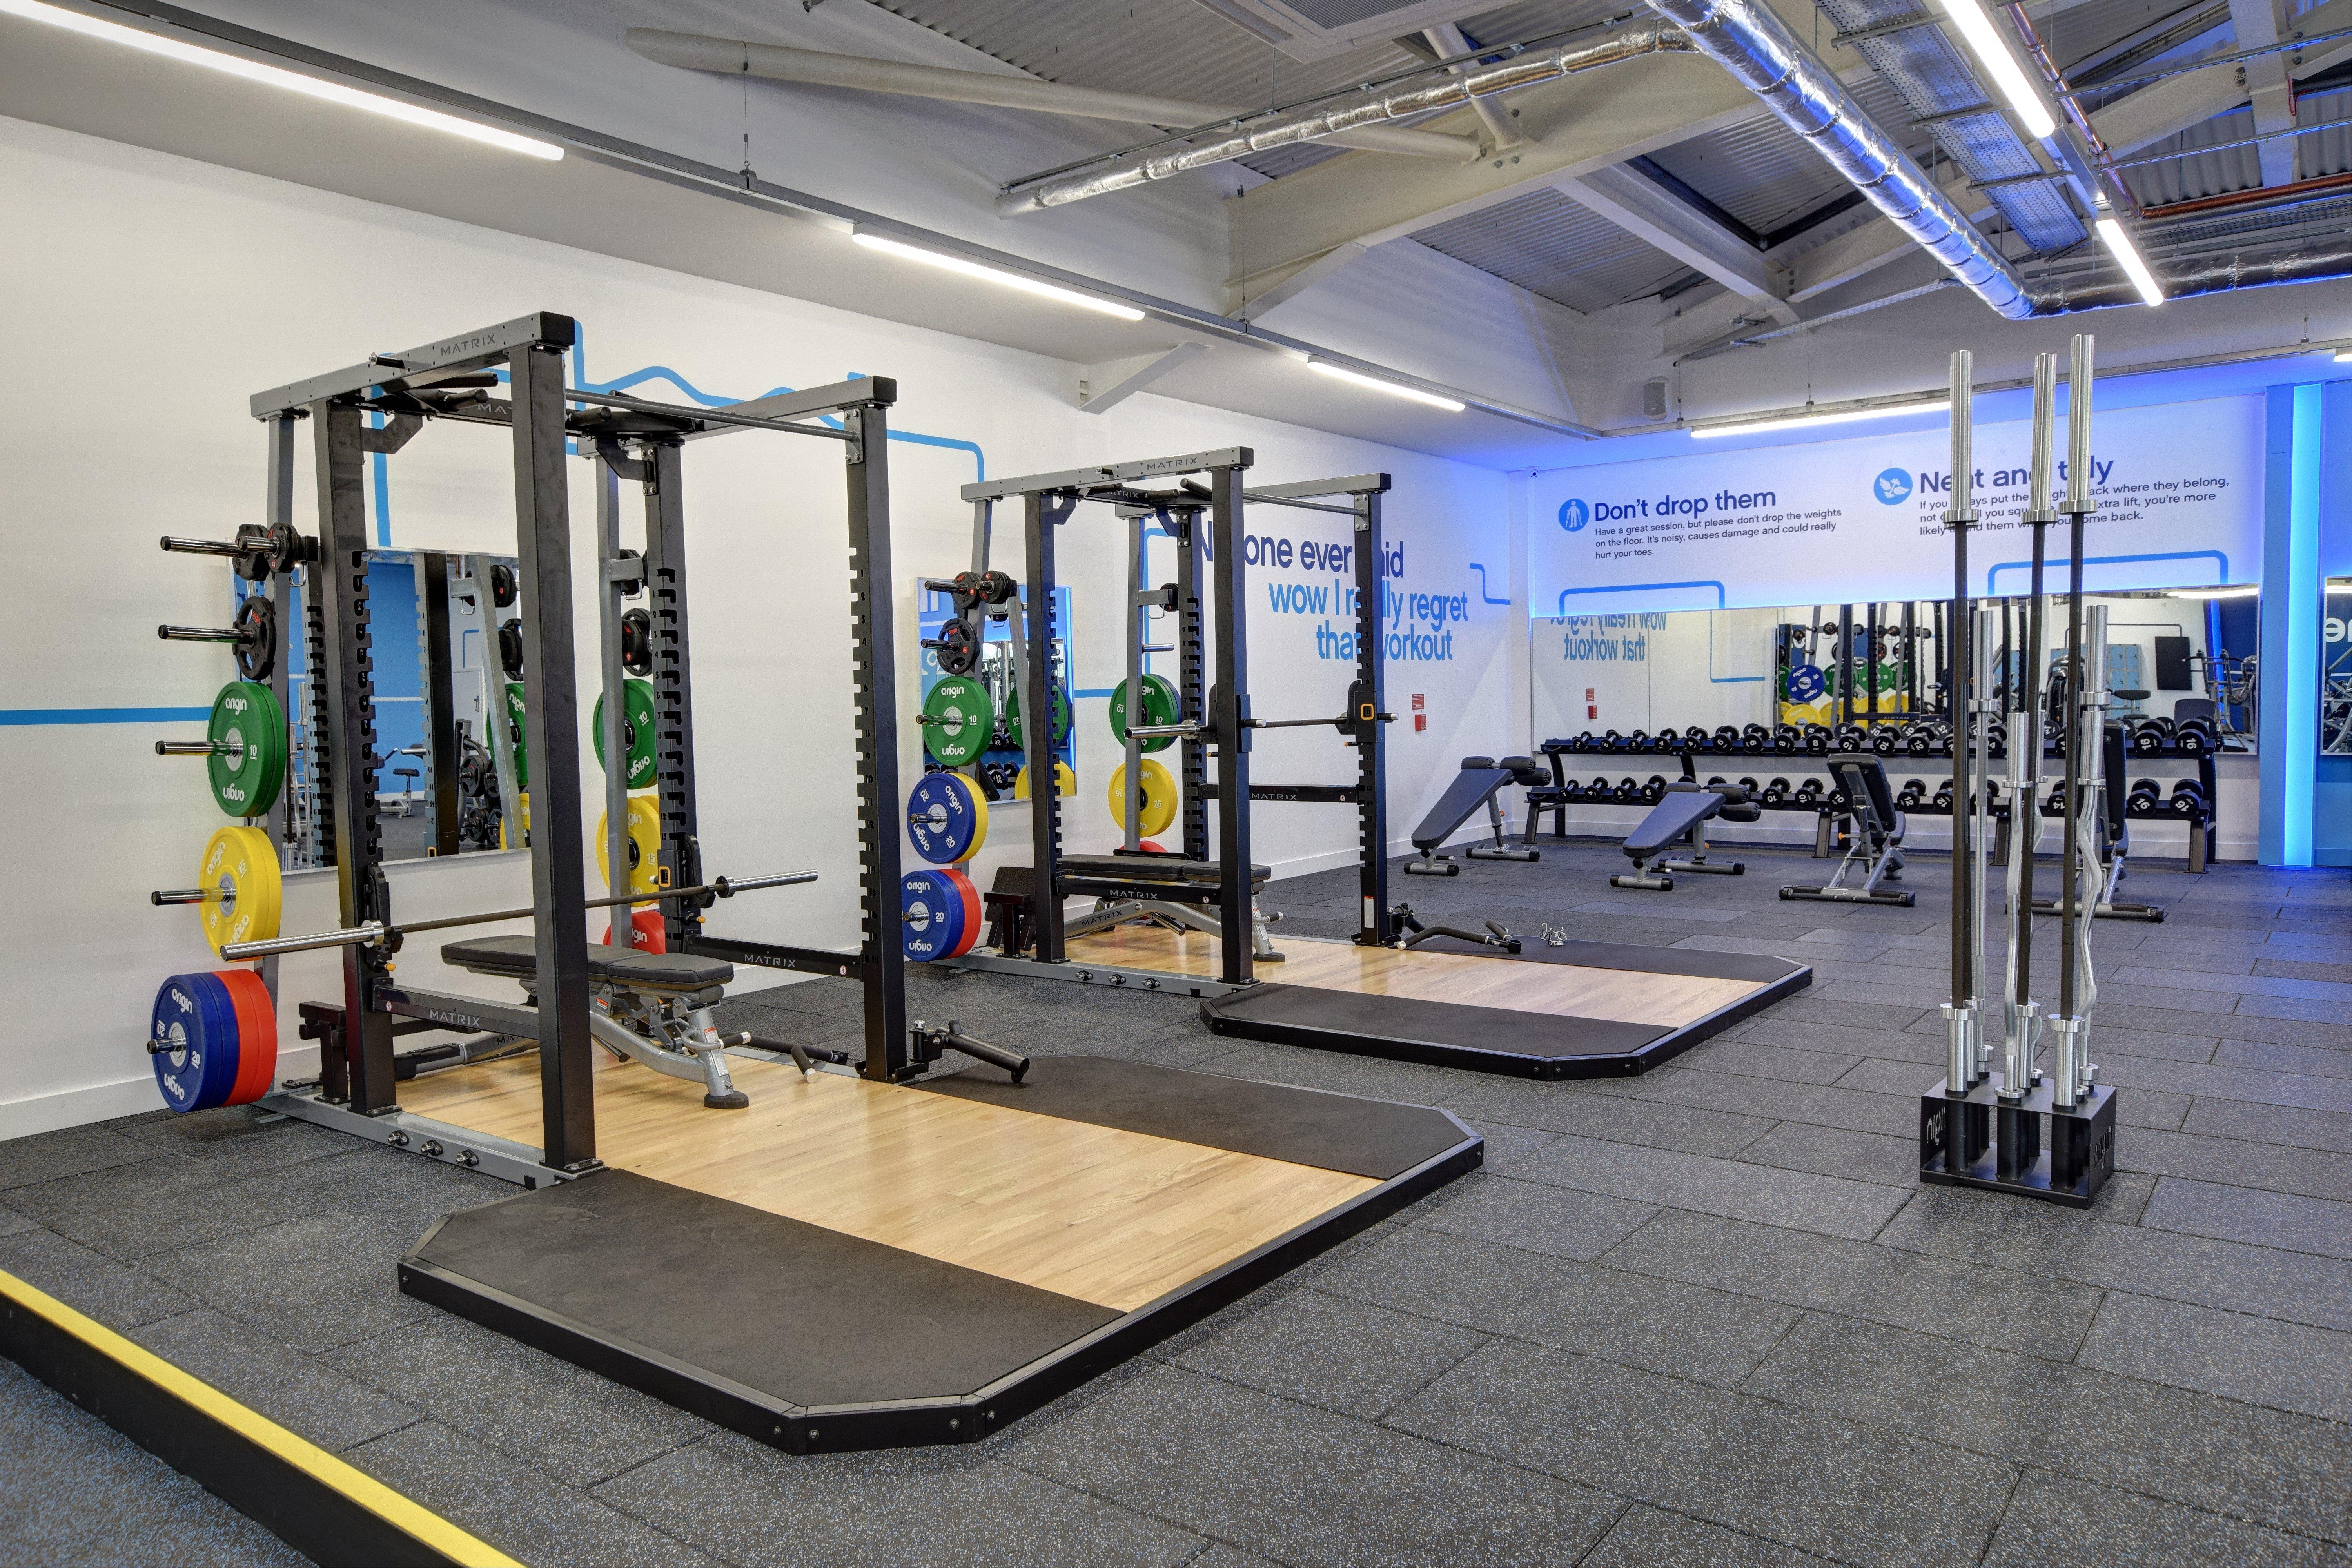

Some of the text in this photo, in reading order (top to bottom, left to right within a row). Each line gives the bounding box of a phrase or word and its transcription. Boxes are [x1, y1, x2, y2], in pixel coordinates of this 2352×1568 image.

[441, 334, 495, 356] MATRIX
[1147, 457, 1197, 470] MATRIX
[1921, 455, 2114, 493] Net an ty
[1107, 490, 1138, 498] ATRIX
[1920, 501, 1926, 509] If
[1930, 501, 1947, 511] you
[1991, 495, 2008, 506] put
[2012, 493, 2029, 501] the
[2089, 485, 2109, 495] ack
[2113, 484, 2149, 493] where
[2154, 481, 2180, 492] they
[2183, 477, 2229, 488] belong,
[1595, 490, 1776, 521] Don't drop them
[1920, 514, 1936, 522] not
[1985, 510, 2004, 519] you
[2098, 500, 2120, 509] xtra
[2124, 497, 2141, 507] lift,
[2145, 495, 2180, 508] you're
[2184, 493, 2216, 502] more
[1626, 525, 1648, 535] great
[1650, 522, 1685, 531] session,
[1705, 518, 1733, 529] please
[1737, 515, 1759, 524] don't
[1762, 514, 1784, 523] drop
[1787, 512, 1801, 520] the
[1804, 508, 1842, 519] weights
[1920, 526, 1945, 536] likely
[1987, 522, 2014, 530] them
[2111, 511, 2143, 521] back.
[1662, 534, 1685, 543] noisy,
[1688, 532, 1719, 540] causes
[1722, 530, 1759, 538] damage
[1762, 526, 1779, 534] and
[1782, 523, 1808, 533] could
[1811, 521, 1837, 532] really
[1244, 534, 1293, 568] one
[1300, 540, 1352, 573] ever
[1382, 541, 1404, 578] id
[1614, 550, 1632, 559] your
[861, 569, 863, 577] 1
[860, 592, 865, 601] 2
[1268, 578, 1468, 632] wow I relly regret
[862, 615, 865, 624] 3
[862, 638, 866, 646] 4
[863, 661, 867, 670] 5
[864, 684, 868, 693] 6
[941, 686, 964, 699] origin
[225, 697, 247, 715] origin
[864, 706, 869, 715] 7
[639, 711, 648, 723] 10
[1155, 715, 1163, 723] 10
[865, 729, 870, 738] 8
[942, 744, 965, 755] origin
[1843, 742, 1853, 750] 10
[1879, 741, 1889, 751] 10
[1914, 740, 1924, 751] 12
[2140, 738, 2151, 750] 16
[2186, 738, 2197, 749] 16
[249, 744, 257, 757] 10
[866, 752, 870, 760] 9
[627, 755, 650, 779] origin
[866, 775, 873, 784] 10
[223, 783, 245, 802] origin
[1799, 794, 1808, 803] 10
[1835, 794, 1844, 803] 10
[945, 785, 962, 815] origin
[1904, 796, 1914, 806] 12
[1936, 797, 1947, 808] 12
[2137, 798, 2150, 809] 16
[2176, 800, 2189, 811] 16
[913, 823, 930, 851] origin
[946, 835, 955, 848] 20
[207, 842, 226, 875] origin
[647, 853, 655, 862] 15
[907, 882, 930, 894] origin
[1110, 889, 1158, 900] MATRIX
[1082, 909, 1123, 927] MATRIX
[909, 939, 932, 951] origin
[745, 954, 796, 968] MATRIX
[172, 989, 193, 1014] origin
[430, 1009, 480, 1027] MATRIX
[192, 1051, 200, 1065] 20
[164, 1073, 185, 1100] origin
